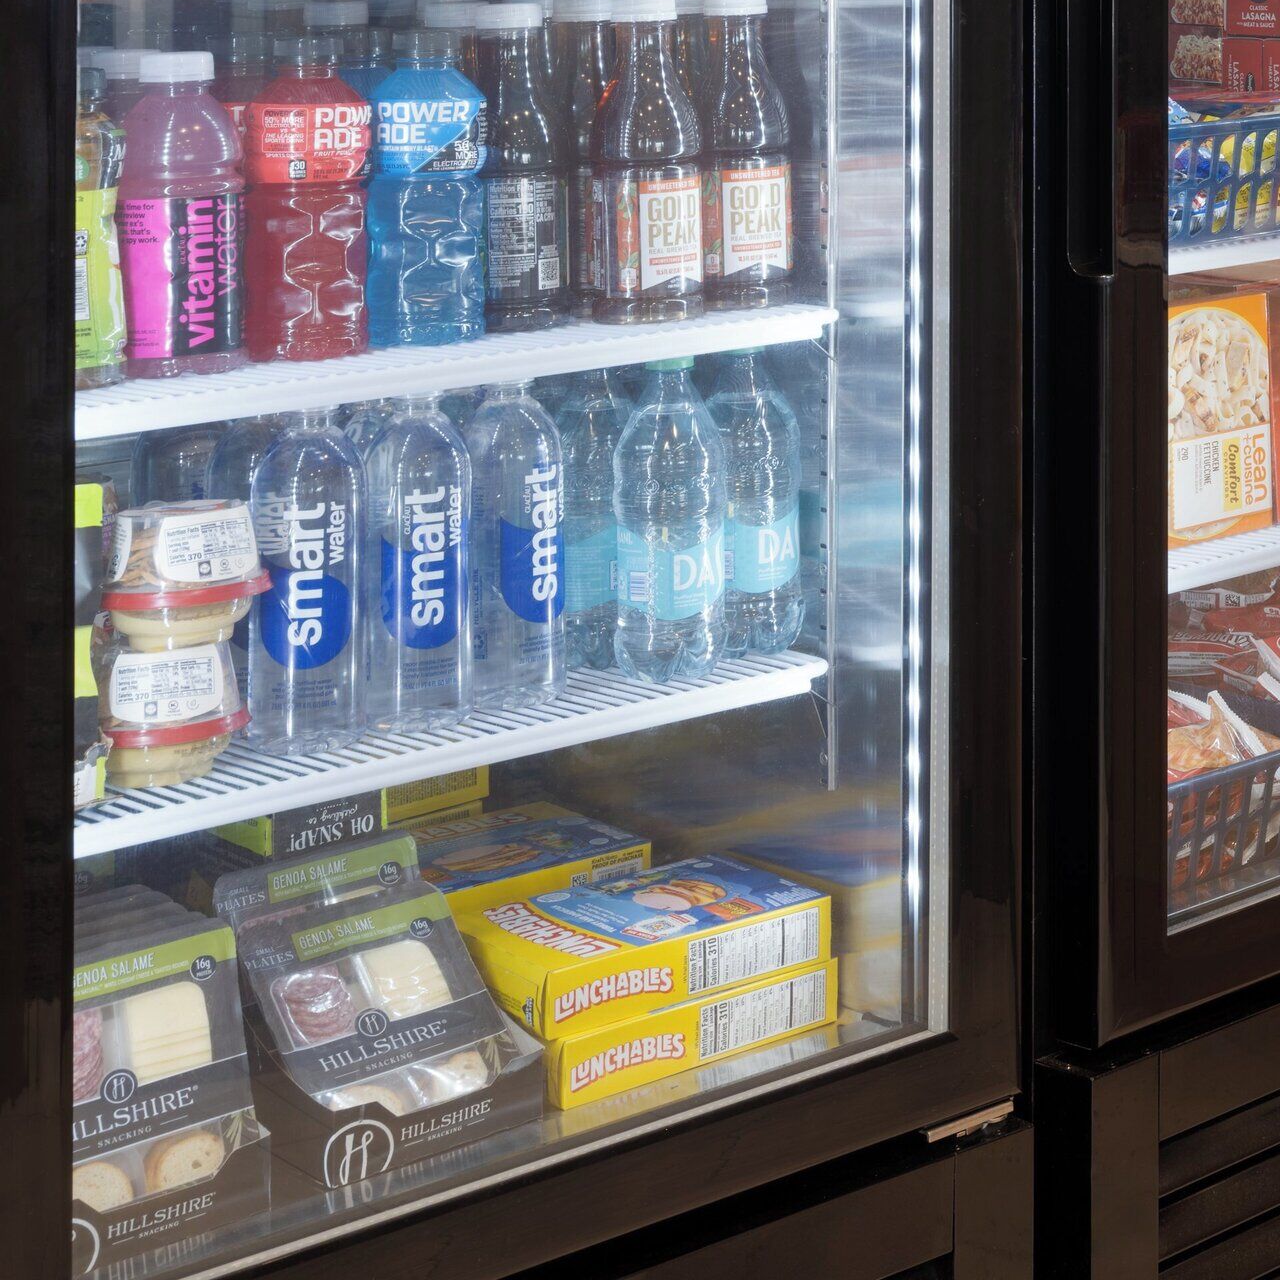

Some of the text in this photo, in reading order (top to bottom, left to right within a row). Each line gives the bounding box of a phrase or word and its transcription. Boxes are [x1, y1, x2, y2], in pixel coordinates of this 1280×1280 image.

[1241, 12, 1277, 22] LASAGNA
[378, 101, 470, 123] POWER
[315, 128, 364, 150] ADE
[377, 123, 427, 145] ADE
[456, 151, 478, 160] MORE
[731, 170, 770, 180] UNSWEETENED
[648, 194, 697, 221] GOLD
[730, 208, 782, 235] PEAK
[217, 198, 237, 297] water
[649, 220, 697, 248] PEAK
[179, 199, 216, 349] vitamin
[1211, 441, 1220, 472] CHICKEN
[1252, 433, 1269, 503] Lean
[1227, 444, 1240, 504] Comfort
[447, 483, 464, 546] water
[328, 500, 346, 566] water
[531, 463, 557, 602] smart
[188, 551, 203, 561] 370
[411, 486, 446, 626] smart
[287, 502, 326, 647] smart
[135, 692, 150, 702] 370
[352, 813, 375, 836] OH
[273, 858, 348, 891] GENOA SALAME
[216, 891, 266, 914] PLATES
[298, 916, 376, 949] GENOA SALAME
[413, 919, 429, 930] 16g
[484, 901, 621, 958] LUNCHABLES
[111, 953, 156, 978] SALAME
[194, 958, 211, 971] 16g
[244, 950, 295, 972] PLATES
[689, 961, 697, 992] Nutrition
[707, 936, 718, 987] Calories 310
[554, 966, 676, 1023] LUNCHABLES
[700, 1007, 709, 1060] Nutrition Facts
[719, 1002, 729, 1054] Calories 310
[319, 1019, 443, 1073] HILLSHIRE
[364, 1051, 413, 1072] SNACKING
[570, 1032, 686, 1093] LUNCHABLES
[400, 1099, 491, 1142] HILLSHIRE
[427, 1123, 463, 1141] SNACKING
[97, 1124, 152, 1149] SNACKING
[107, 1194, 212, 1240] HILLSHIRE
[138, 1220, 180, 1239] SNACKING
